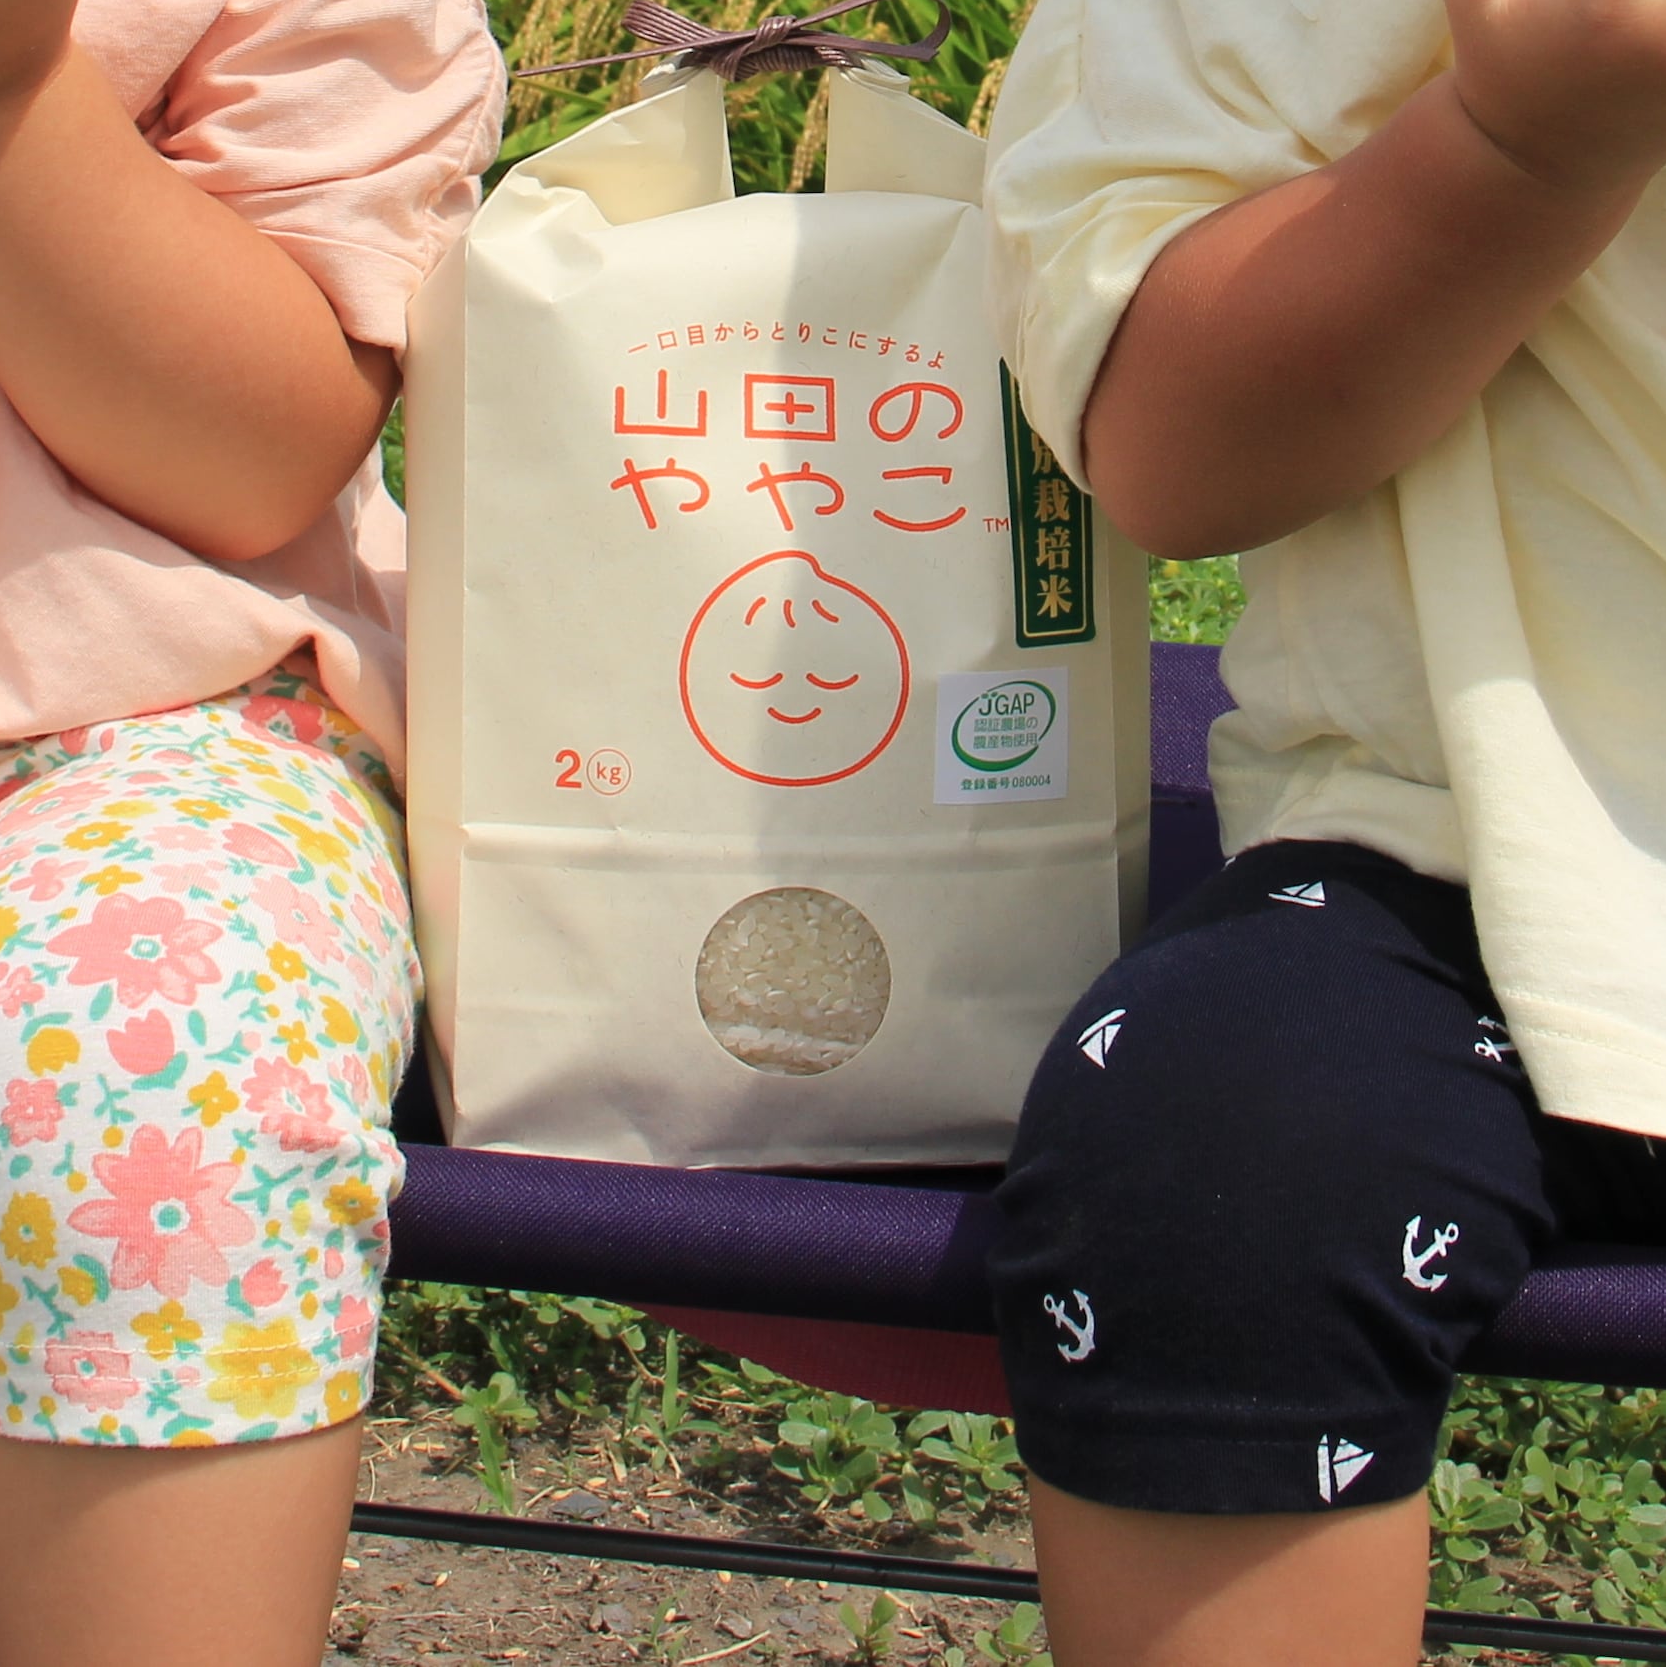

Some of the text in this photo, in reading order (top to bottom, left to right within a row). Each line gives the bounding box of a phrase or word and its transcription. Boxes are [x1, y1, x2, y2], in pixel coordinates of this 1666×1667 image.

[626, 320, 945, 369] 一口目からとりこにするよ
[614, 369, 964, 442] 山田の
[610, 458, 966, 532] ややこ
[983, 517, 1010, 533] TM
[978, 691, 1035, 716] JGAP
[555, 749, 622, 789] 2 kg
